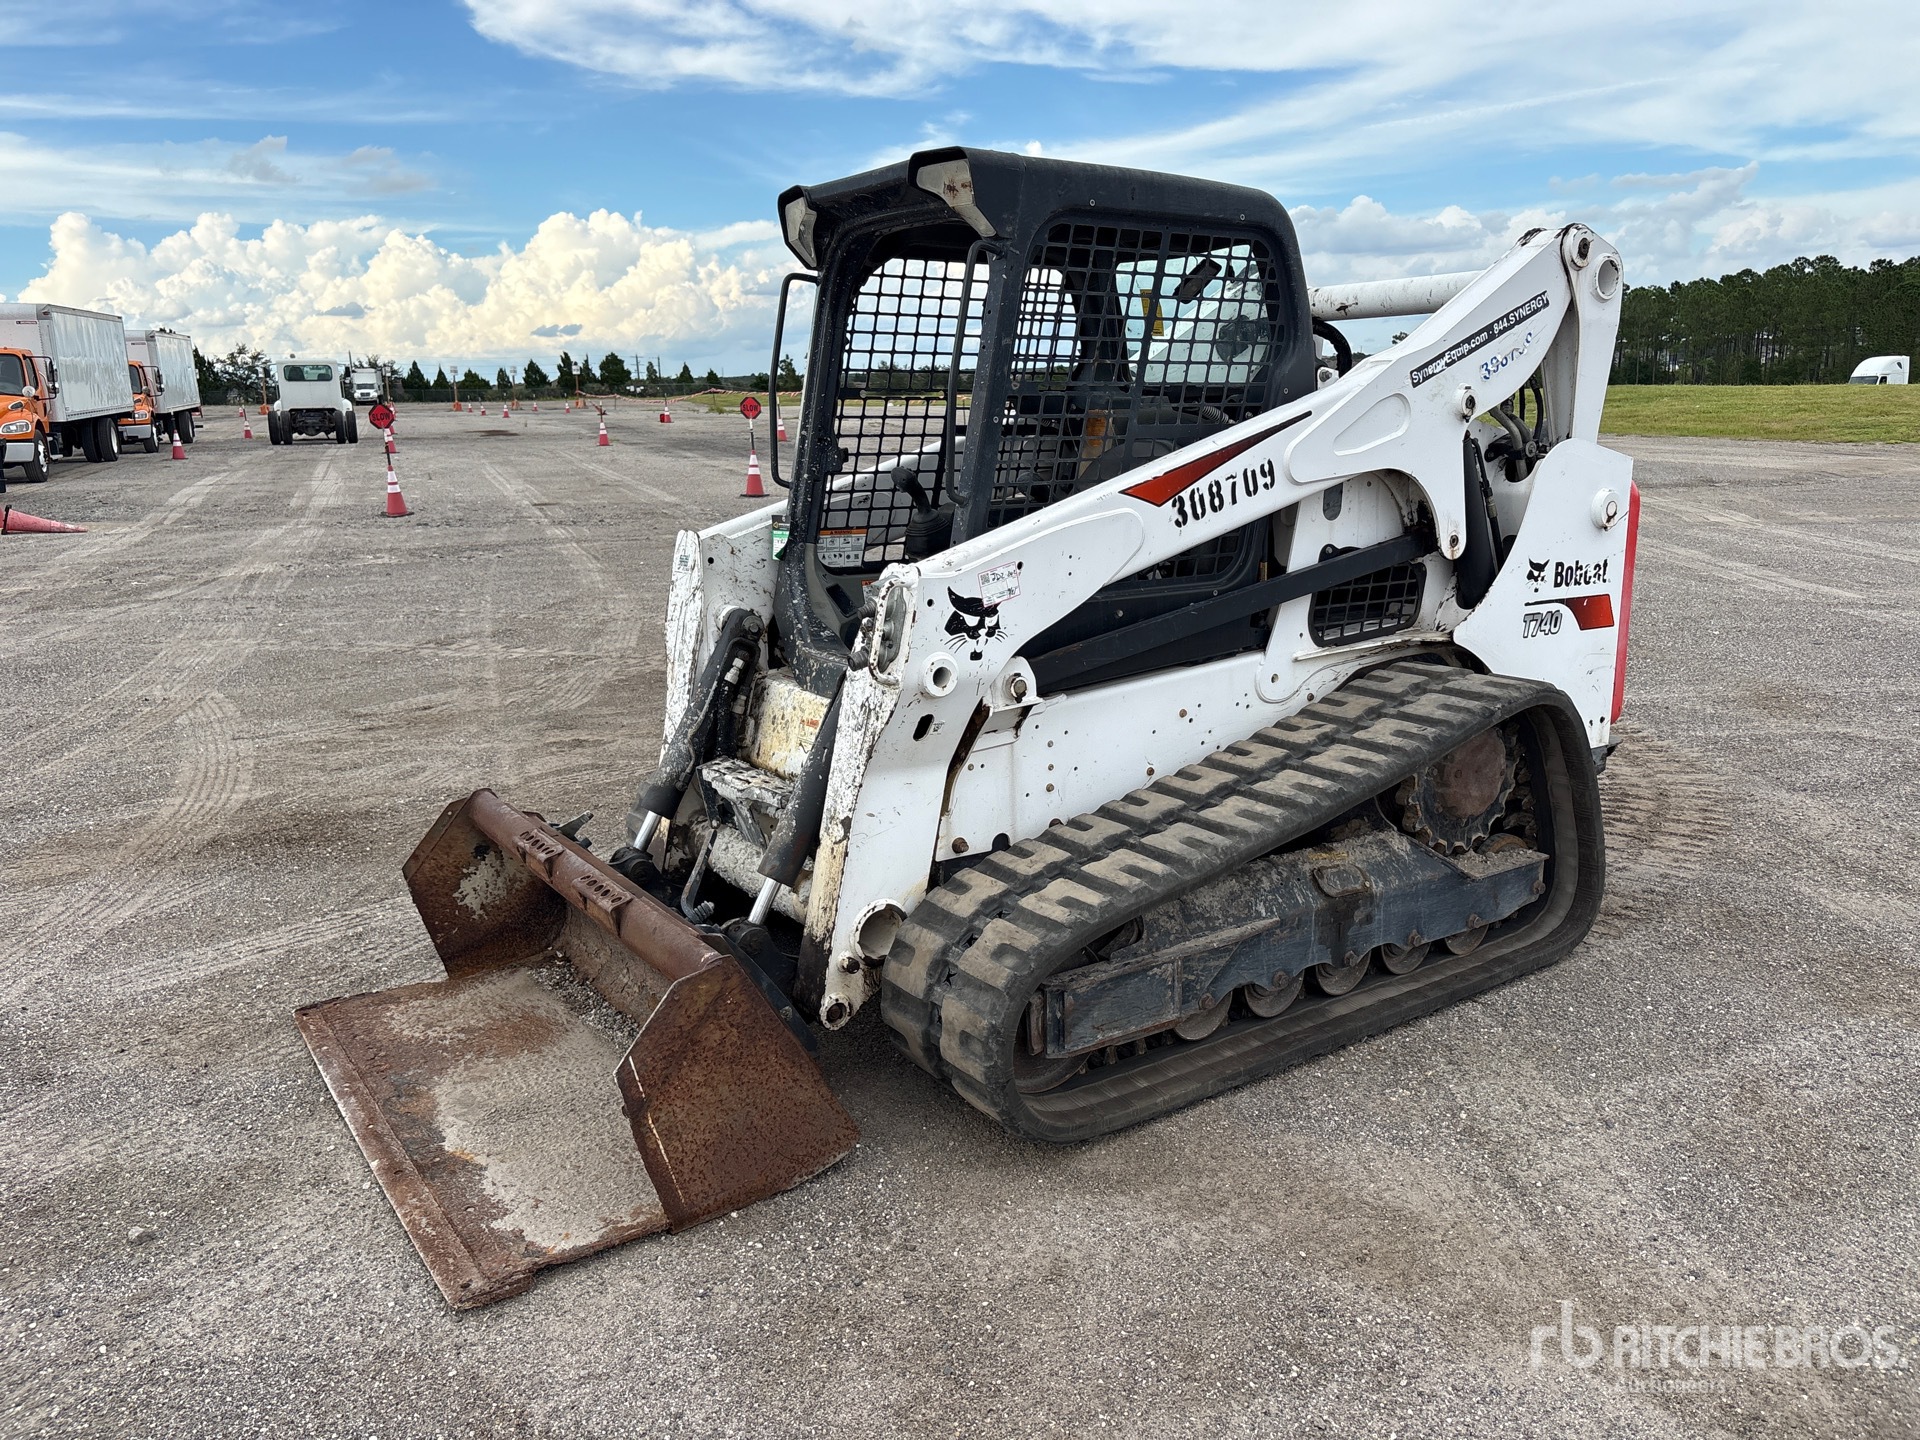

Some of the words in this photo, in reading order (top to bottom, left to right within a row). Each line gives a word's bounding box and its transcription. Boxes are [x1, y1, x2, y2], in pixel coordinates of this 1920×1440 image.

[1493, 293, 1549, 334] 844.SYNERGY
[372, 413, 390, 421] SLOW
[743, 404, 758, 412] SLOW
[1171, 458, 1276, 528] 308709
[1553, 559, 1608, 588] Bobcat
[1523, 609, 1563, 639] T740
